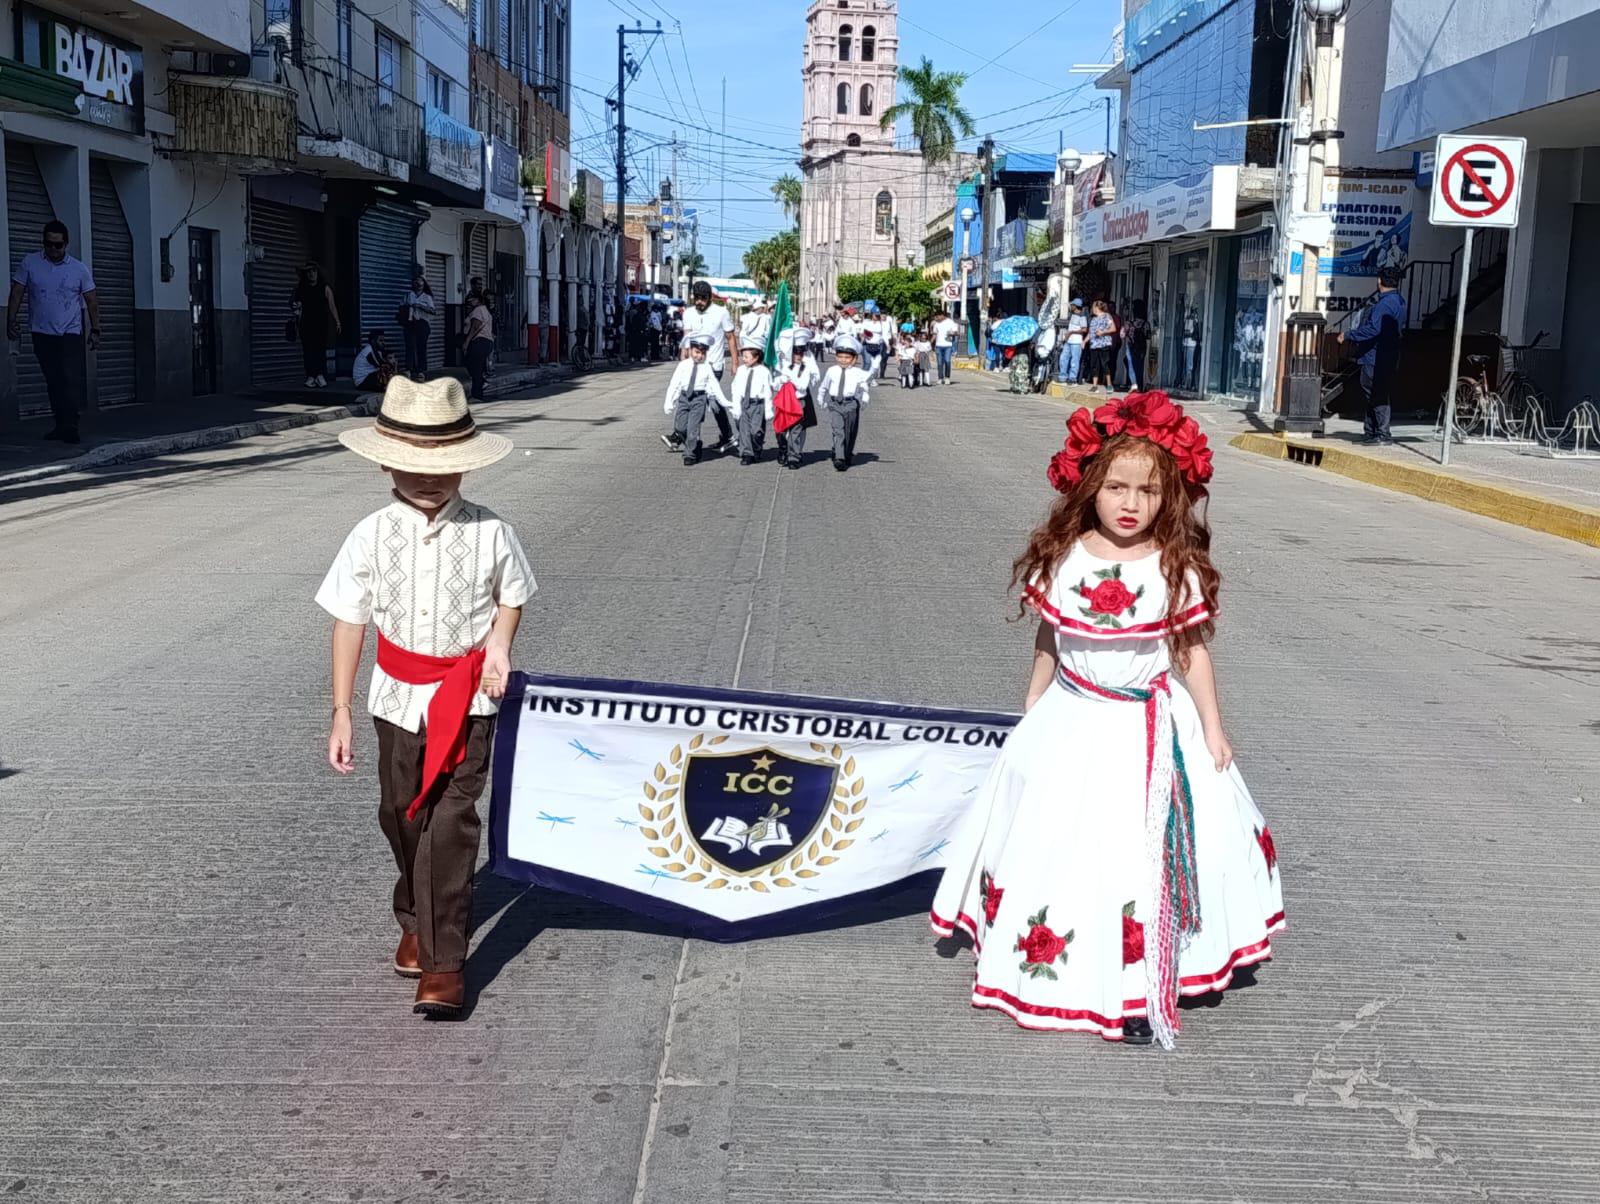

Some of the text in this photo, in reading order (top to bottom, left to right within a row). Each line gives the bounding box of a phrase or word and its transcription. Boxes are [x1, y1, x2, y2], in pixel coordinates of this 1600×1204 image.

[55, 22, 133, 106] BAZAR
[1321, 203, 1402, 215] EPARATORIA
[1331, 215, 1397, 226] VERSIDAD
[529, 694, 1008, 749] INSTITUTO CRISTOBAL COLÓN
[722, 771, 794, 795] ICC
